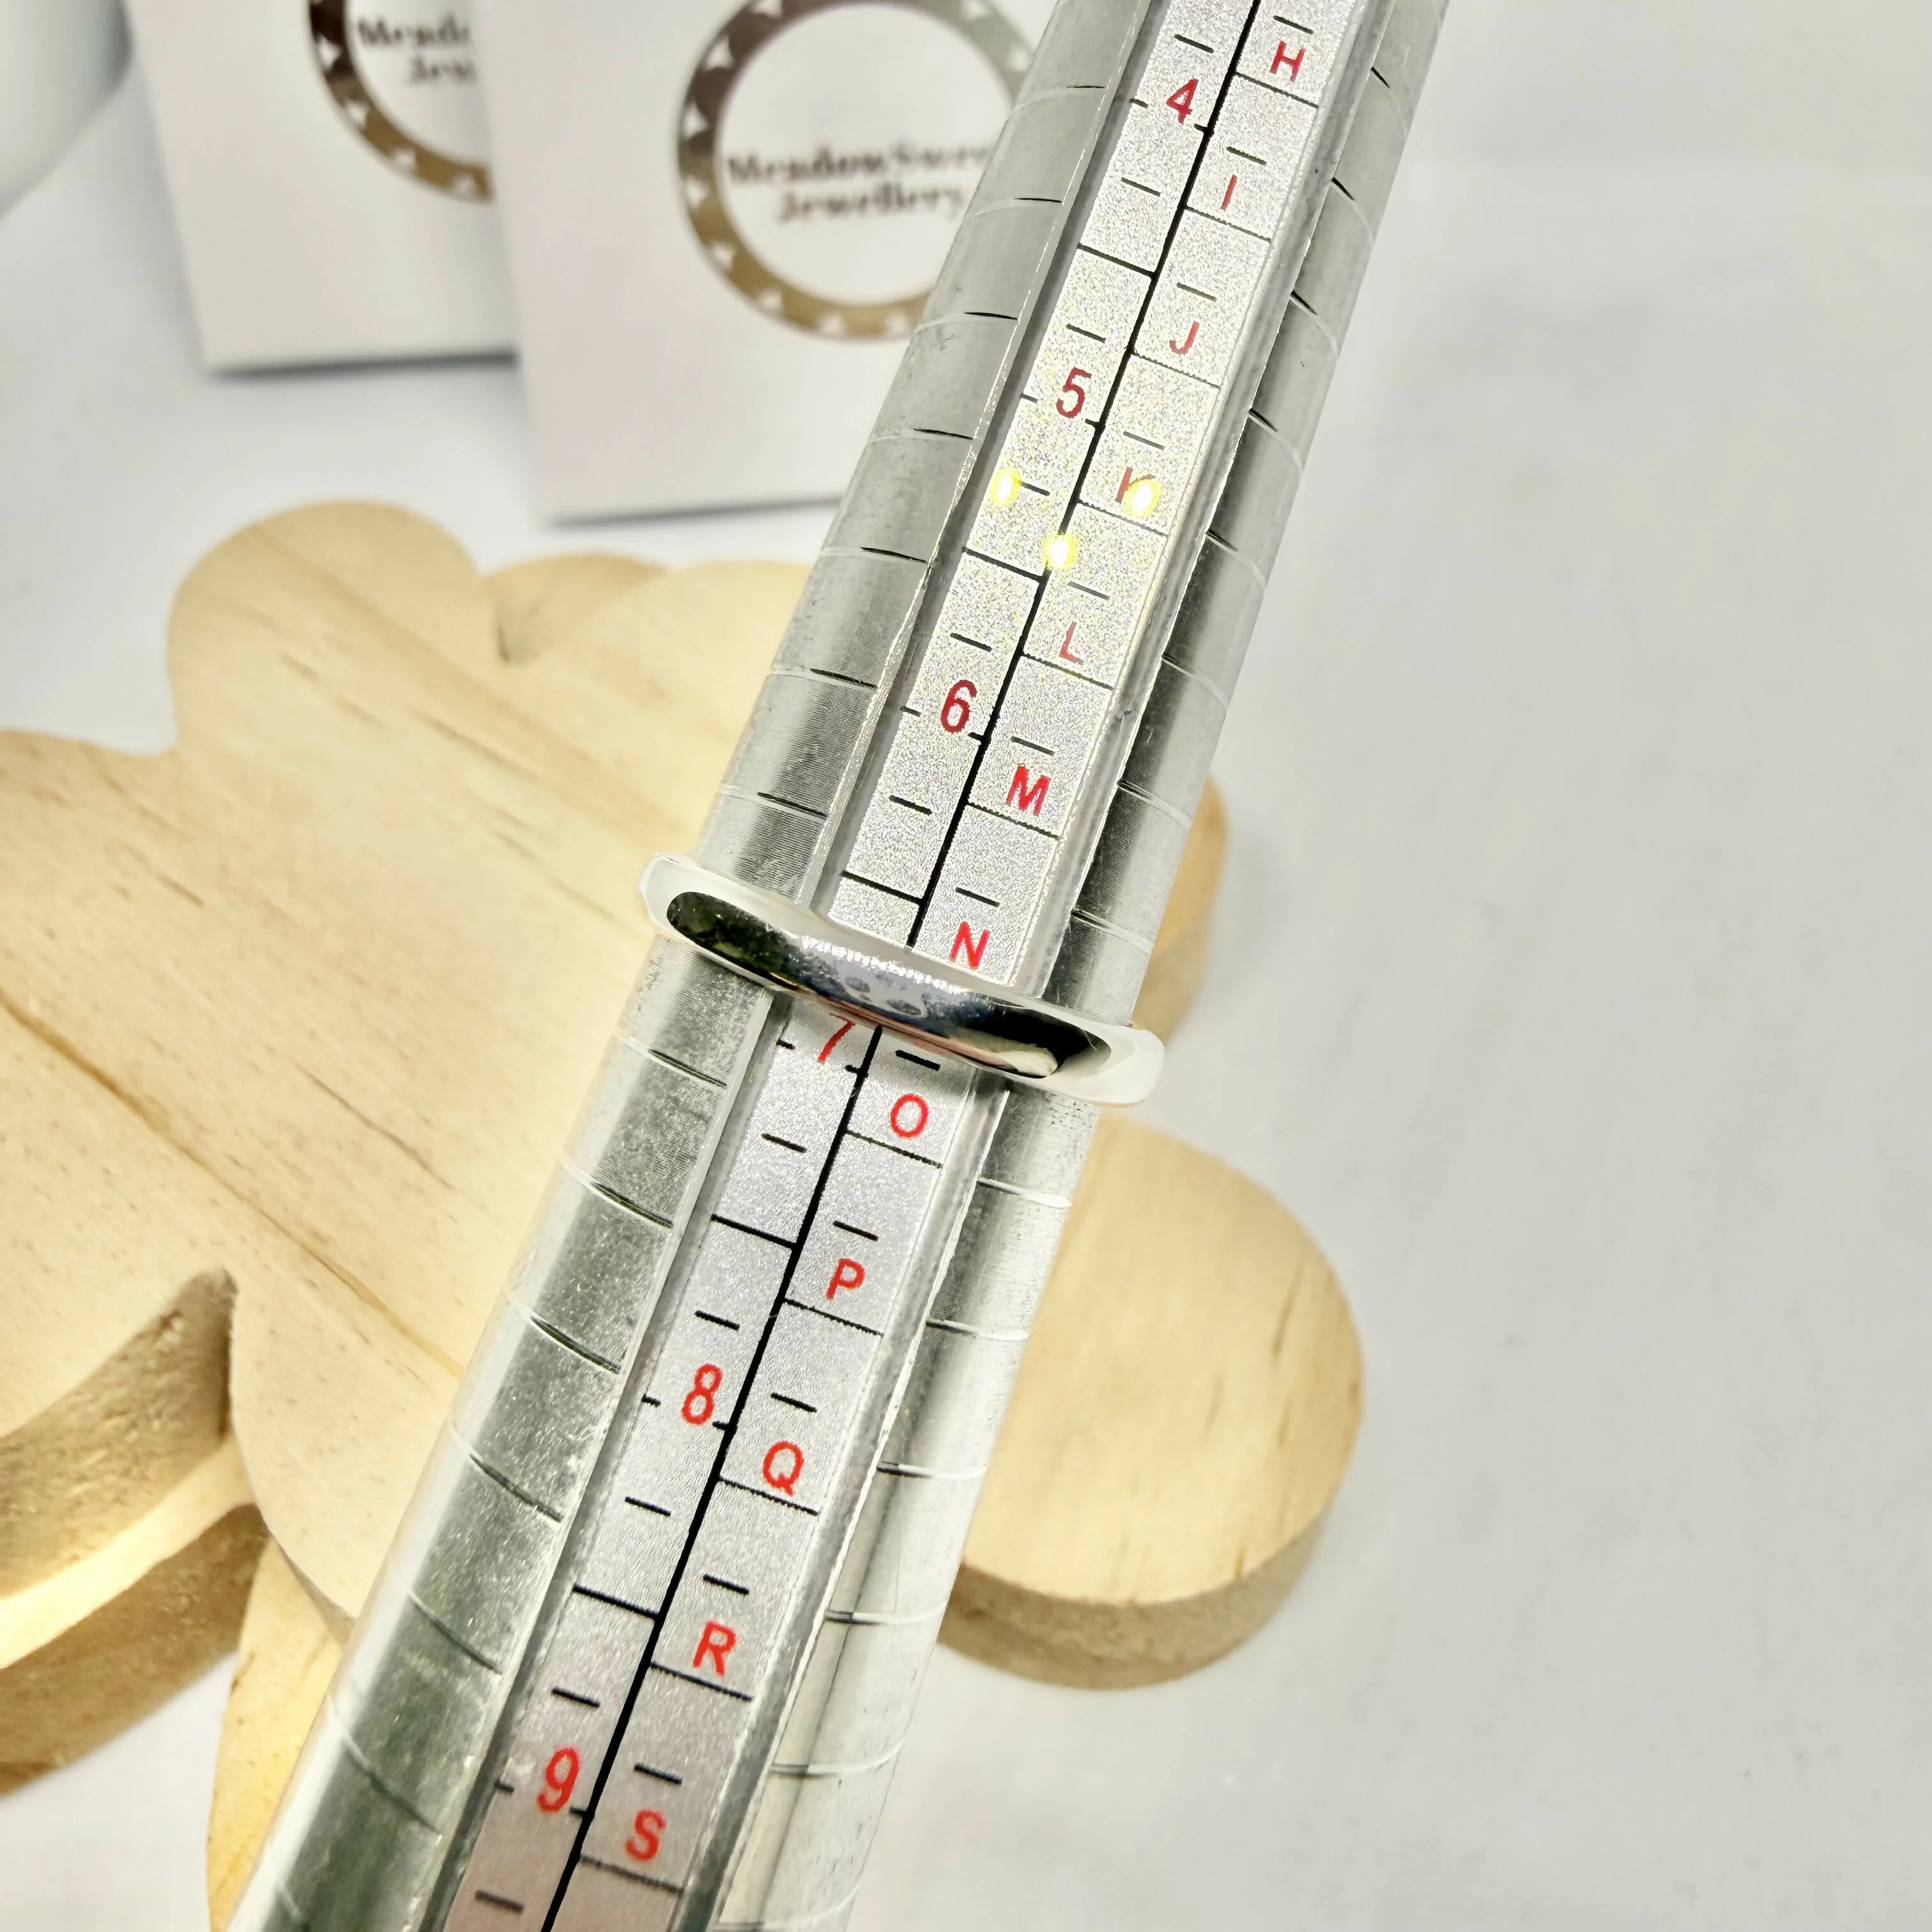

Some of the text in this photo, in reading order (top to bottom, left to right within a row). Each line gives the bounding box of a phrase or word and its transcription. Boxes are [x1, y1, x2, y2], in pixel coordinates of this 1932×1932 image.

[1269, 41, 1306, 81] H
[1167, 79, 1199, 123] 4
[1221, 175, 1238, 210] I
[1170, 321, 1199, 354] J
[1056, 367, 1092, 418] 5
[1059, 622, 1084, 665] L
[940, 679, 977, 733] 6
[1006, 763, 1052, 816] M
[949, 921, 990, 970] N
[889, 1092, 930, 1139] O
[825, 1257, 866, 1301] P
[681, 1363, 723, 1426] 8
[762, 1440, 805, 1496] Q
[692, 1620, 737, 1677] R
[535, 1745, 582, 1814] 9
[624, 1808, 667, 1864] S
